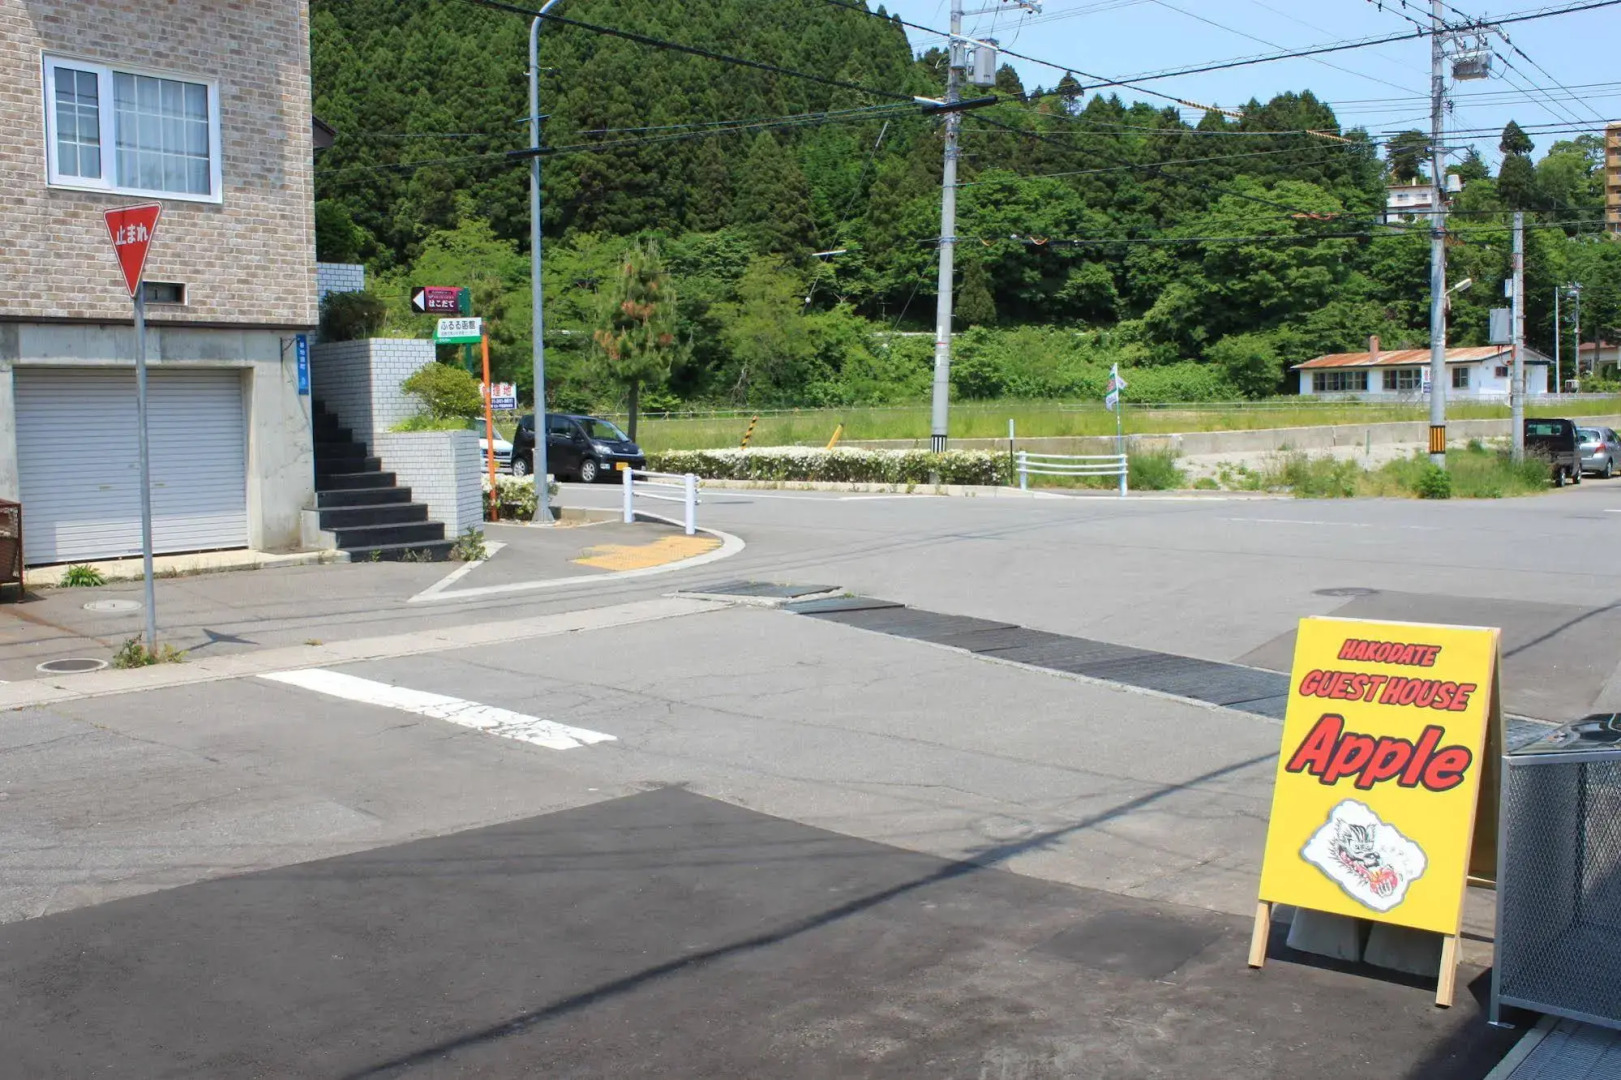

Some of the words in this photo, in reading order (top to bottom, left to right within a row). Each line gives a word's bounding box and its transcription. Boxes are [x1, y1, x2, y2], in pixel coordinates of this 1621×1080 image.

[115, 222, 148, 245] 止まれ
[428, 300, 454, 308] はこだて
[441, 321, 475, 330] ふるる函館
[1338, 639, 1441, 667] HAKODATE
[1299, 669, 1388, 702] GUEST
[1379, 677, 1477, 711] HOUSE
[1285, 713, 1472, 792] Apple
